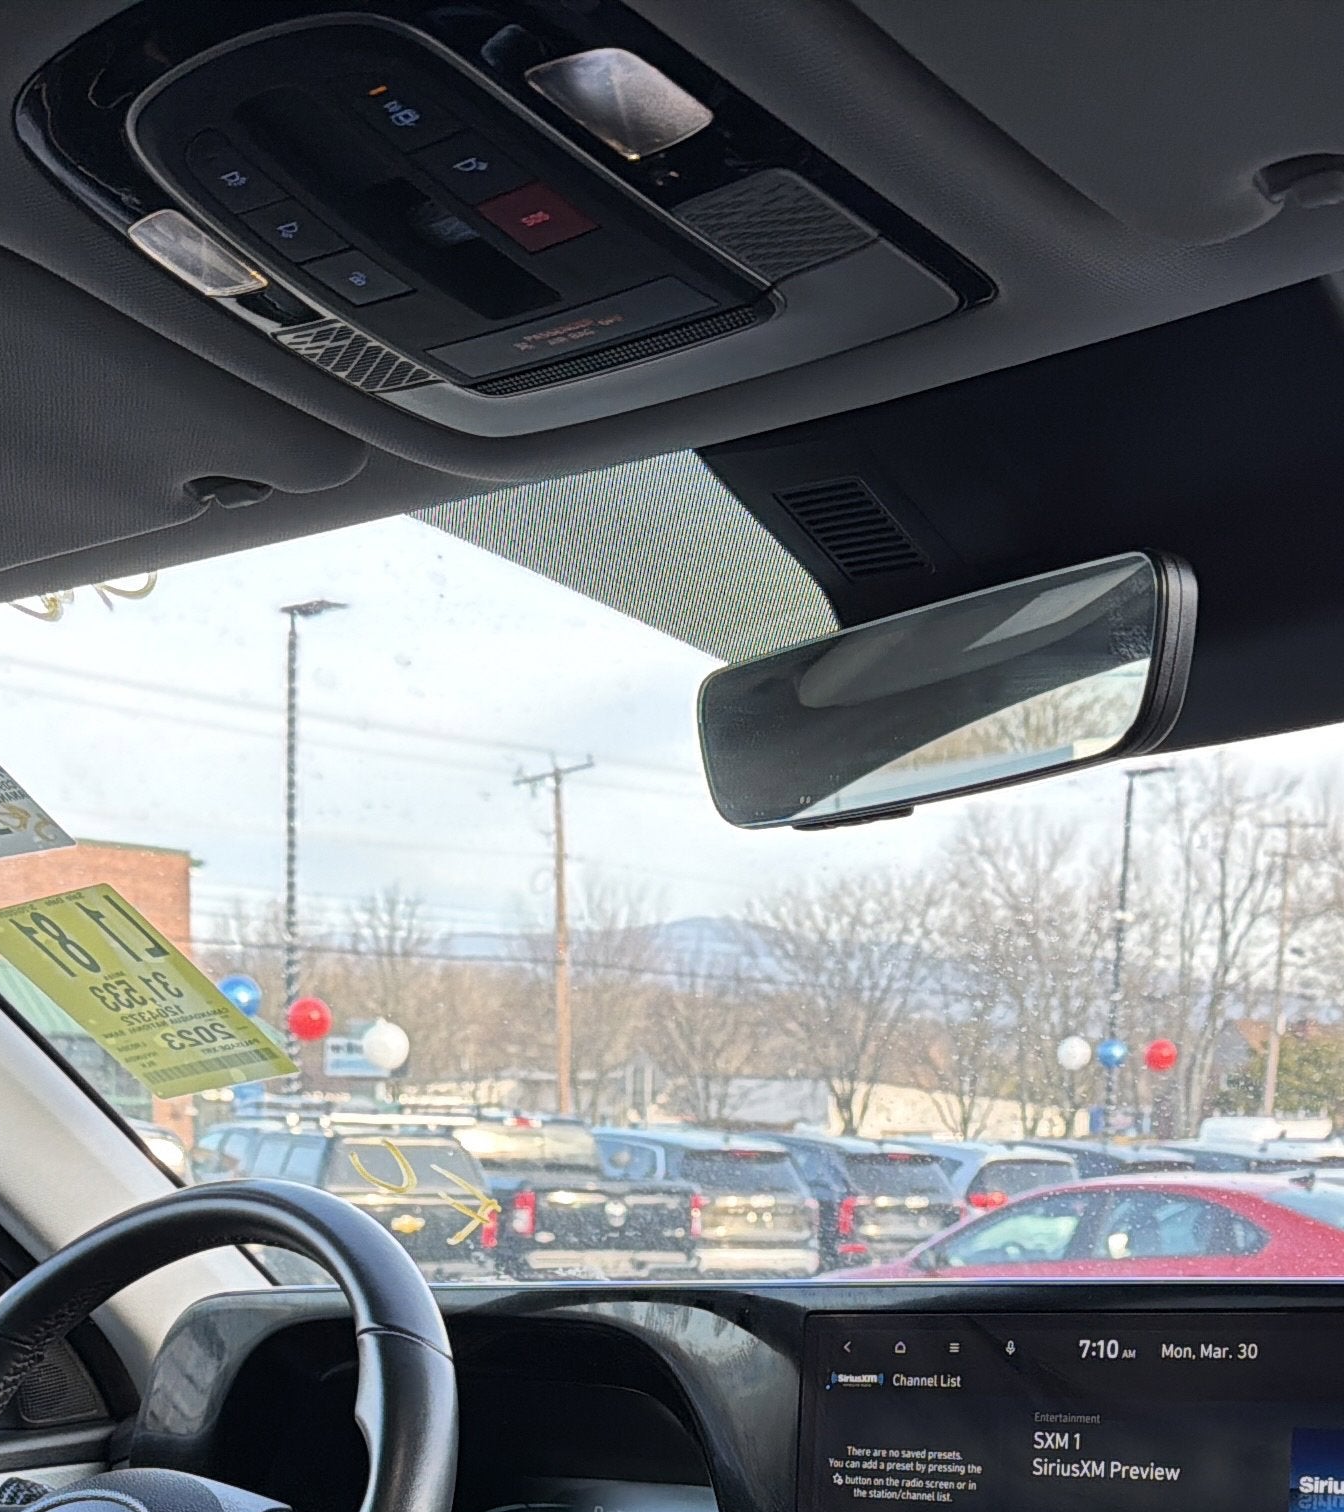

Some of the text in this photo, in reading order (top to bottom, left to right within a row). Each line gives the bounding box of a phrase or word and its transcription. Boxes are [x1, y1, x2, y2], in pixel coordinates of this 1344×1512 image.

[1078, 1339, 1258, 1360] 7:10 AM Mon, Mar. 30
[892, 1373, 961, 1388] Channel List
[1034, 1412, 1101, 1424] Entertainment
[1033, 1431, 1081, 1450] SXM 1
[847, 1445, 963, 1461] There are no saved presets.
[828, 1457, 844, 1468] You
[845, 1460, 860, 1469] can
[862, 1459, 878, 1470] add
[886, 1461, 914, 1472] preset
[915, 1461, 926, 1473] by
[928, 1463, 966, 1475] pressing
[967, 1463, 983, 1474] the
[1032, 1457, 1181, 1481] SiriusXM Preview
[845, 1475, 977, 1490] button on the radio screen or in
[853, 1488, 953, 1502] the station/channel list.
